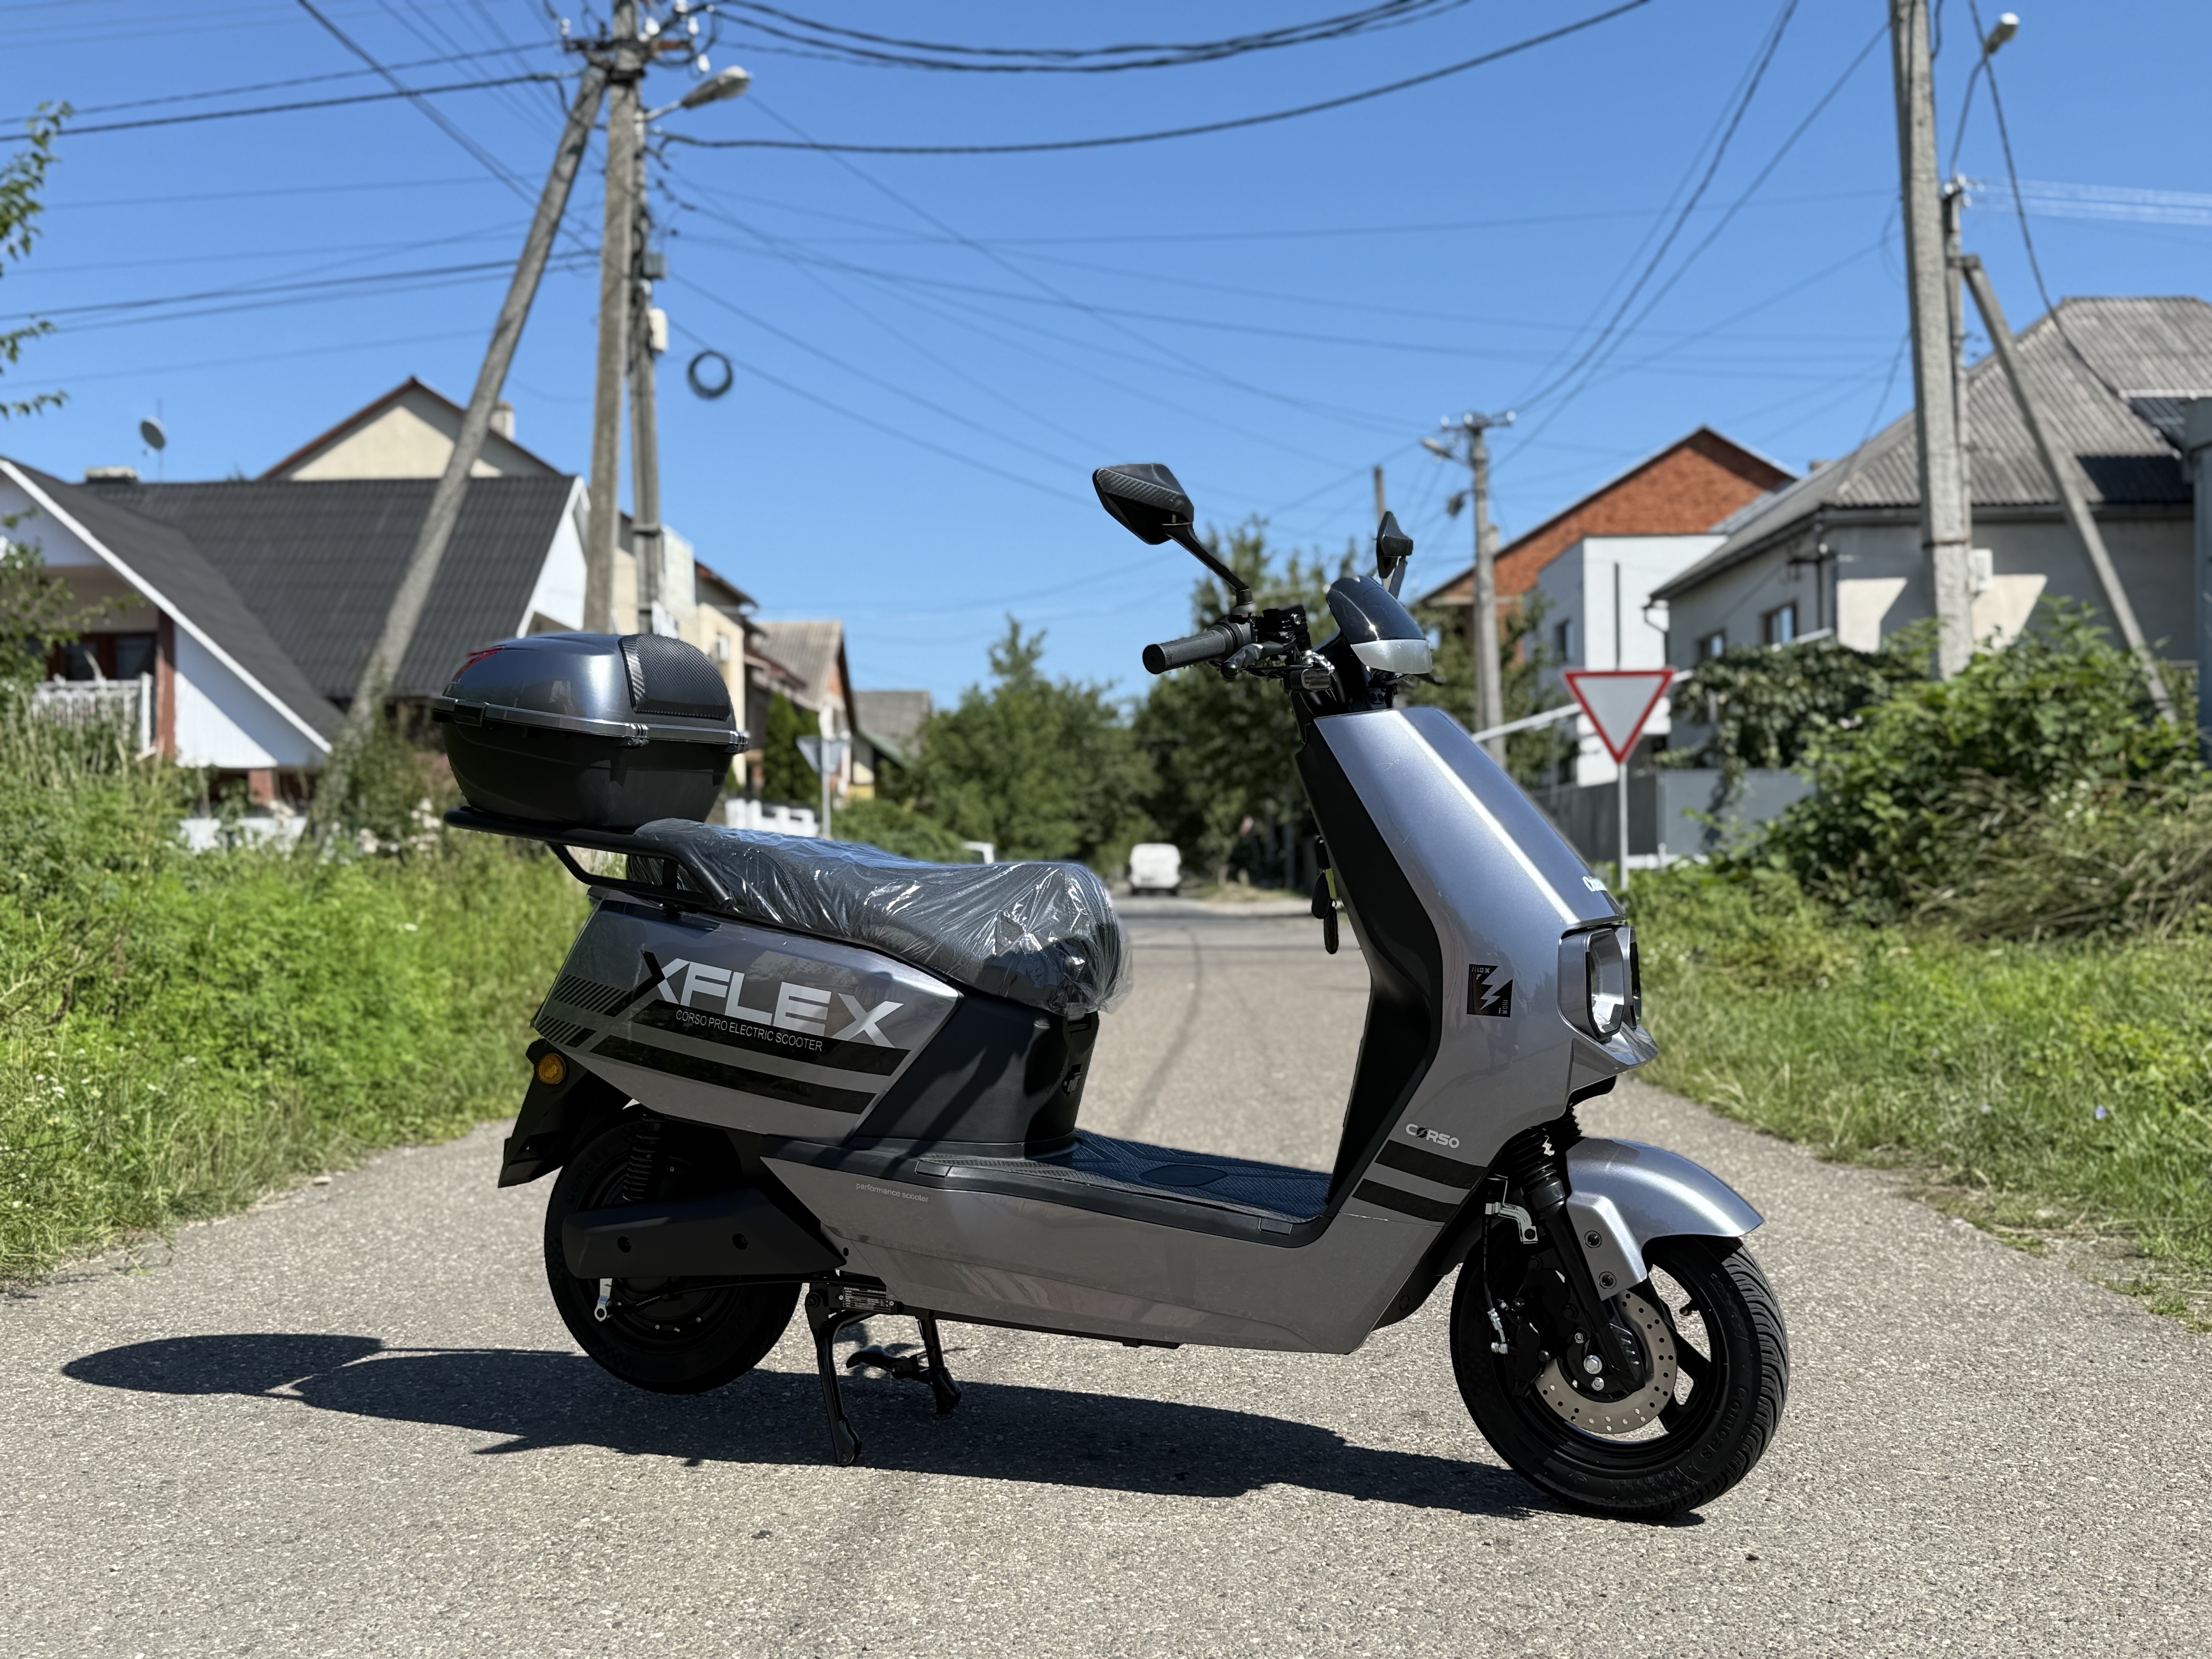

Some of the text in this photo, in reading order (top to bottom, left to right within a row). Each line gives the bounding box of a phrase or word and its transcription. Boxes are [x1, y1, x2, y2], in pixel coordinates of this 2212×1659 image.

[637, 950, 903, 1048] XFLEX
[676, 1010, 823, 1052] CORSO PRO ELECTRIC SCOOTER
[1406, 1123, 1460, 1149] CORSO
[856, 1183, 929, 1202] performance scooter
